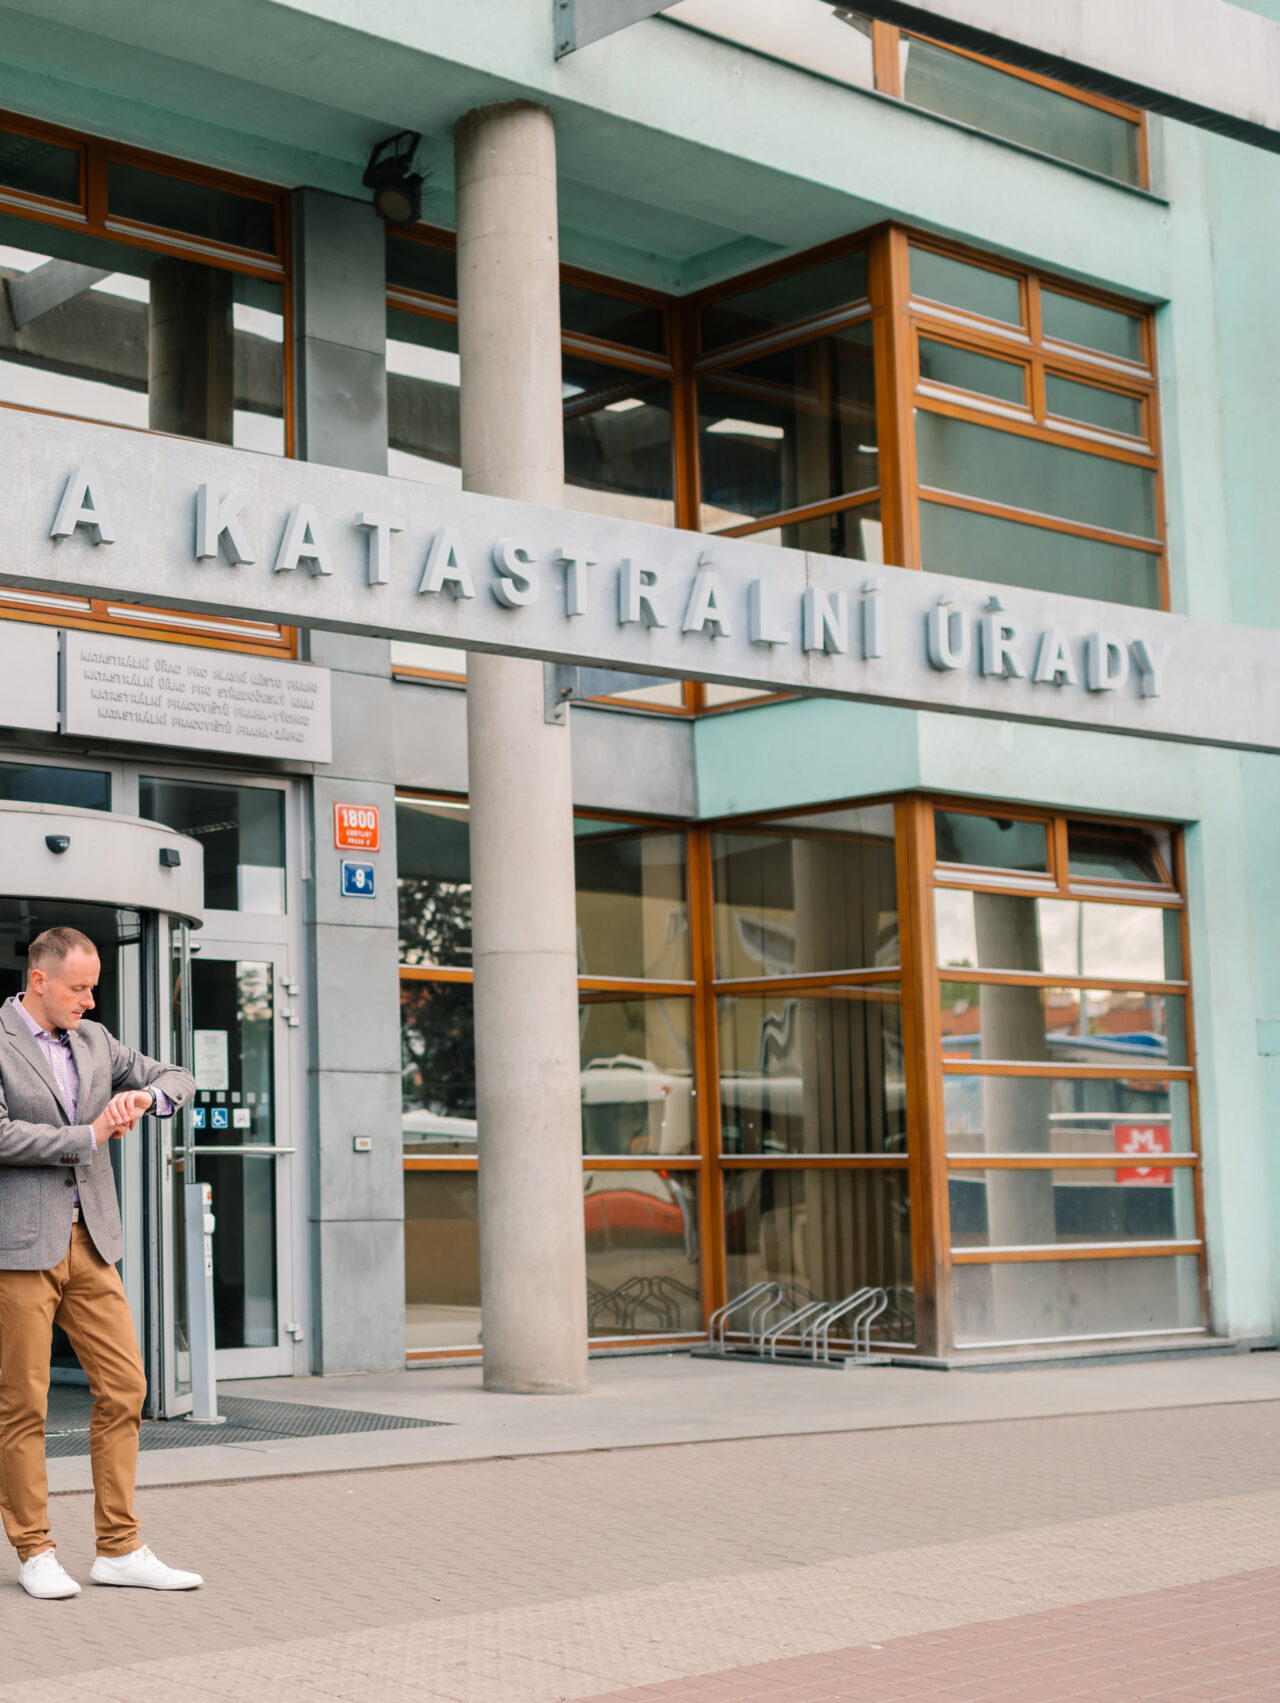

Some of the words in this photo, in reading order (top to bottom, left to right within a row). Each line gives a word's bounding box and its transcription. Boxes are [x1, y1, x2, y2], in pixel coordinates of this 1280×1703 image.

[50, 464, 116, 546] A
[194, 482, 888, 660] KATASTRÁLNÍ
[927, 591, 1174, 699] ÚŘADY
[186, 665, 208, 679] PRO
[191, 683, 212, 697] PRO
[342, 809, 375, 828] 1800
[355, 869, 366, 889] 9
